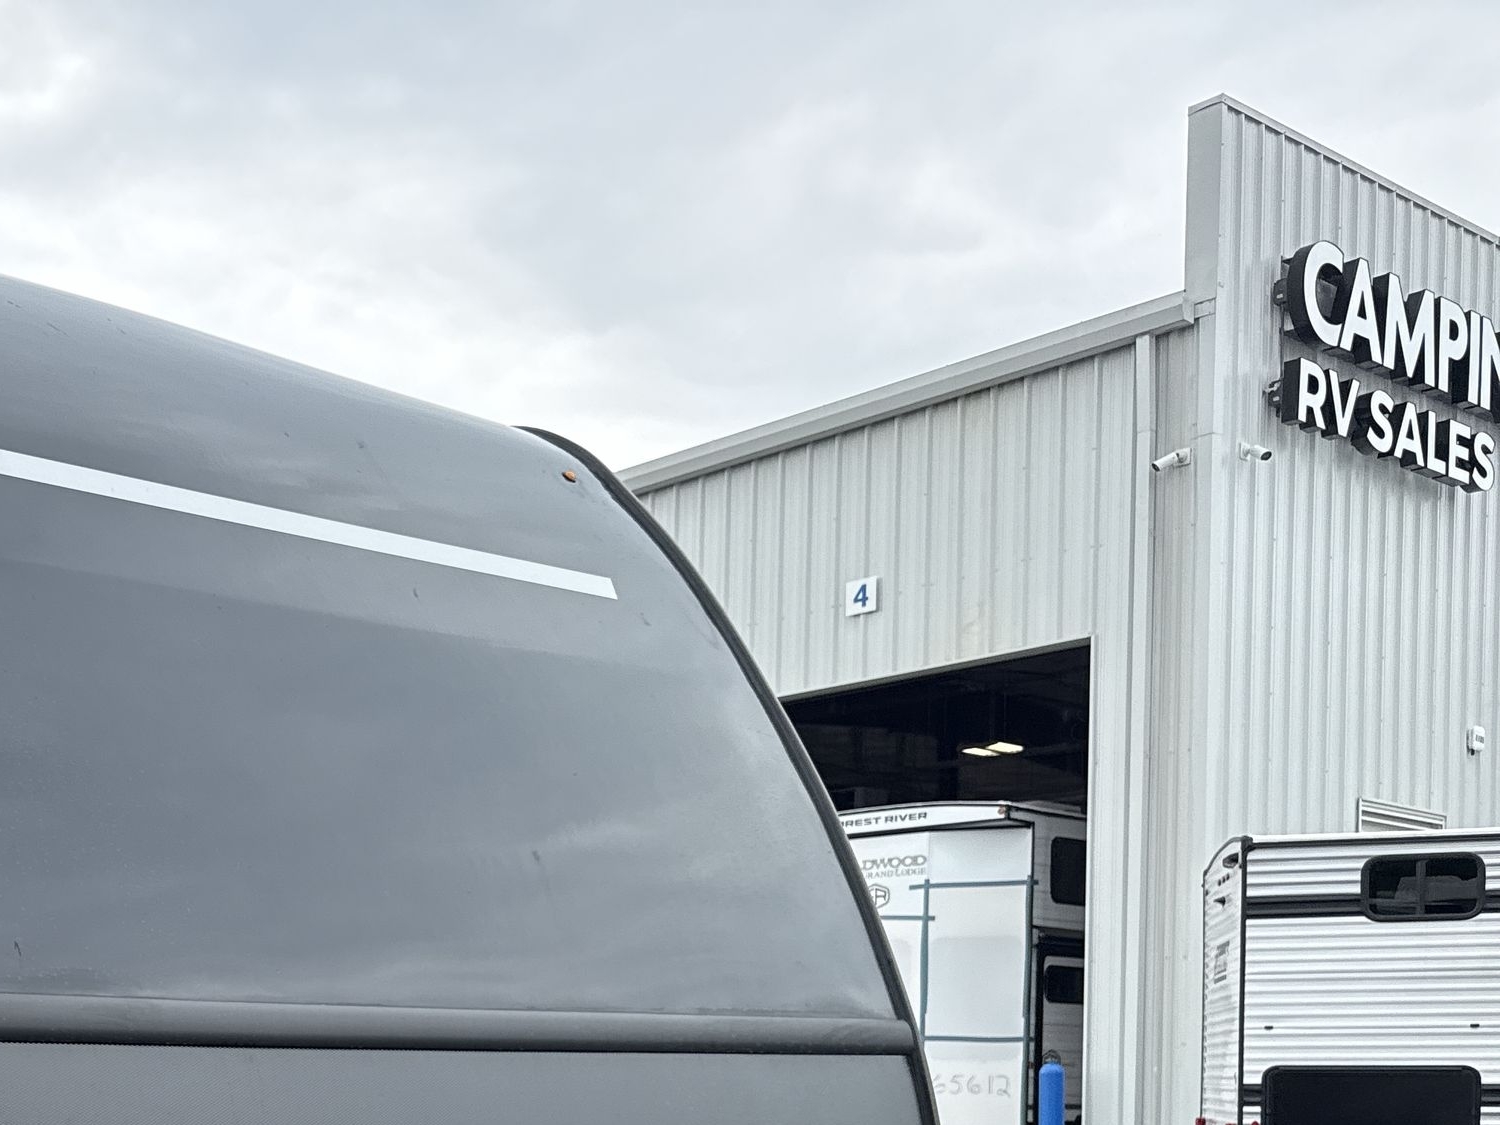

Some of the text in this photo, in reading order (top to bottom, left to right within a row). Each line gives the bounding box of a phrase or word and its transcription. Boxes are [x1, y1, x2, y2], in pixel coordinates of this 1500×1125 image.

[1297, 356, 1496, 492] RV SALES
[853, 583, 869, 608] 4
[841, 811, 928, 829] REST RIVER
